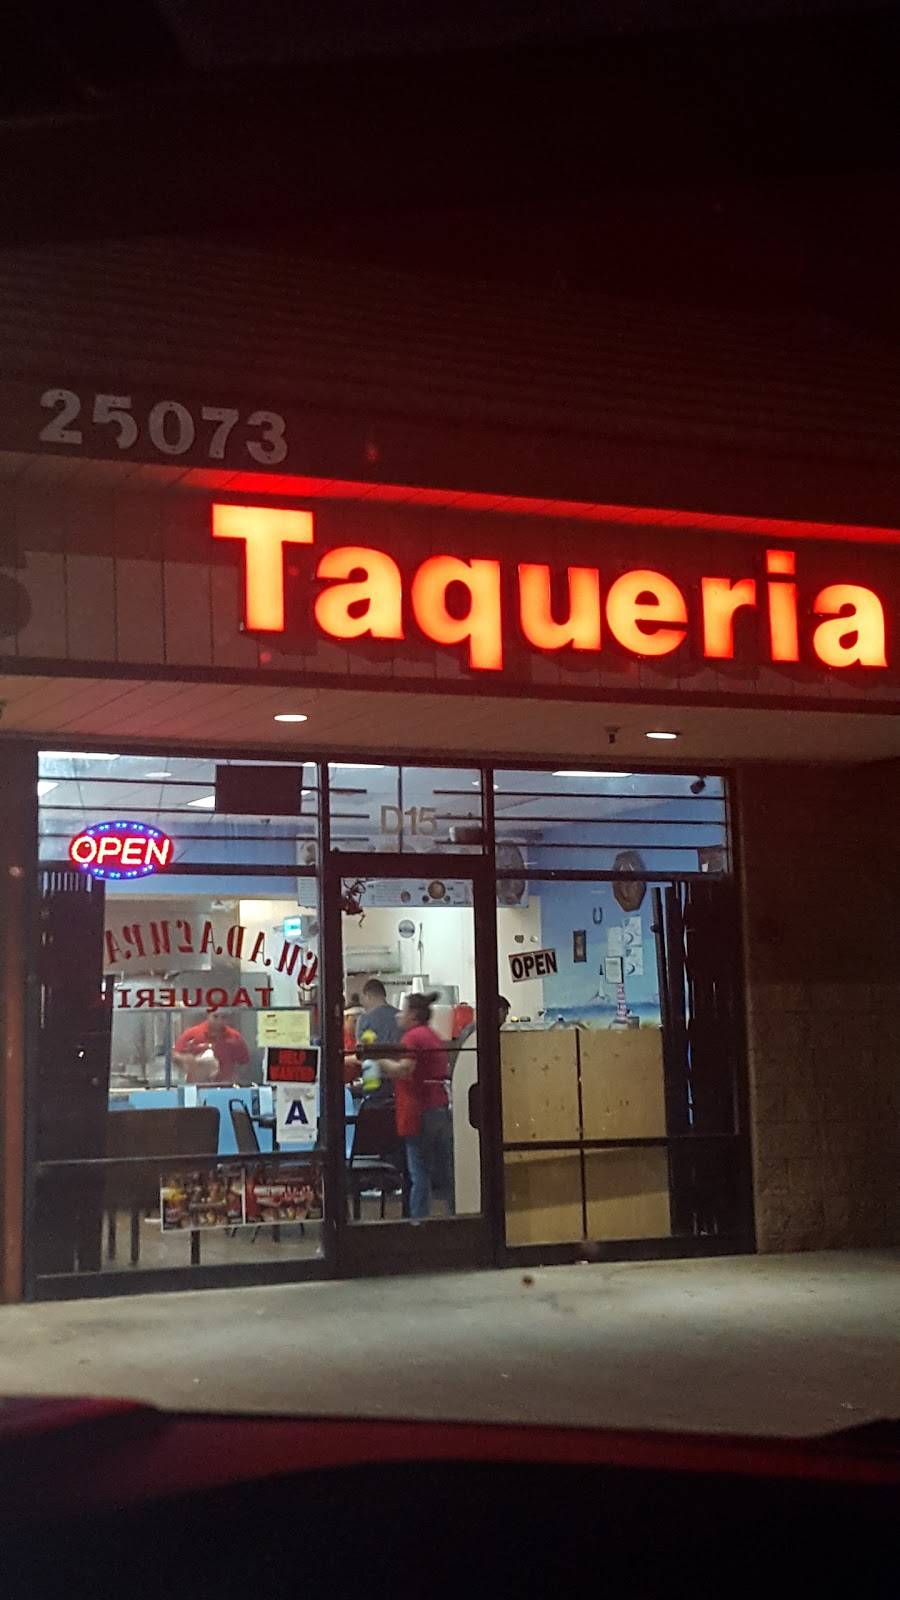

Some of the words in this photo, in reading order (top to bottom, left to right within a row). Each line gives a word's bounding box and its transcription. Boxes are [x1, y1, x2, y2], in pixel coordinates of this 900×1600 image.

[39, 389, 288, 465] 25073
[212, 502, 888, 671] Taqueria
[381, 805, 437, 836] D15
[70, 836, 170, 866] OPEN
[511, 951, 558, 979] OPEN
[285, 1099, 309, 1125] A
